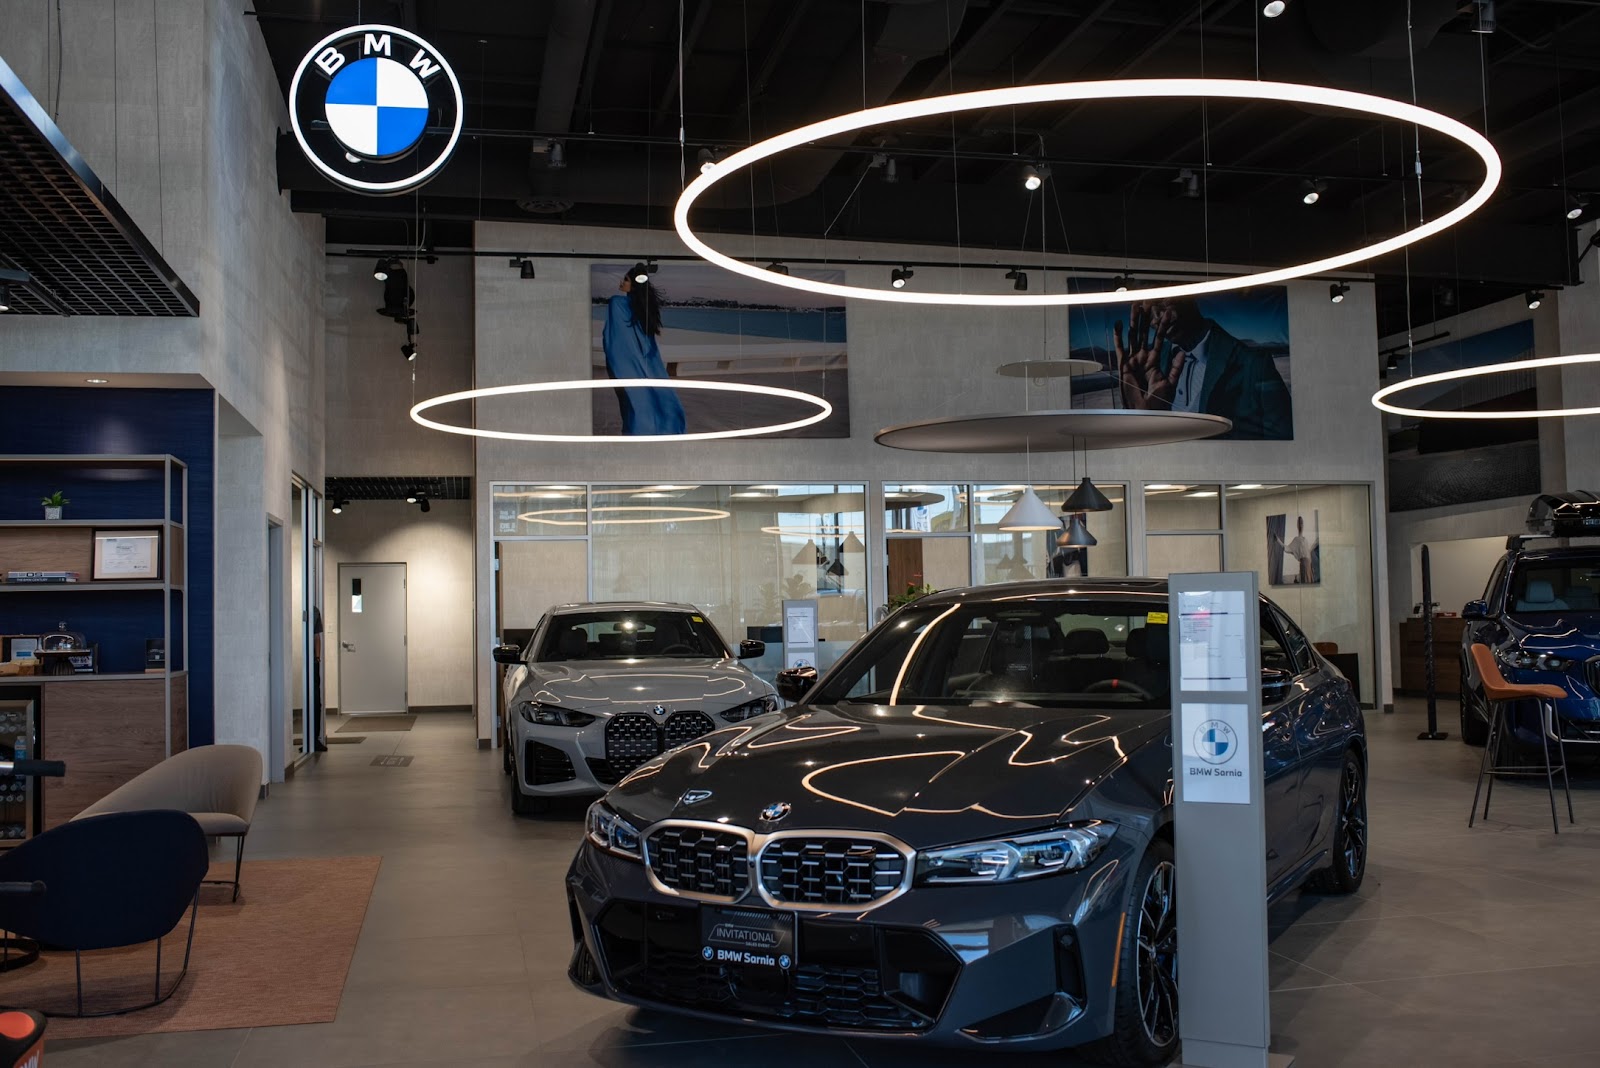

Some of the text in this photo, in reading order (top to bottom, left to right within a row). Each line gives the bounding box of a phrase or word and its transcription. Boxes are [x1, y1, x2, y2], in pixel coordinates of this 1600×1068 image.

[314, 34, 441, 79] BMW
[1199, 722, 1231, 734] BMW
[1214, 768, 1242, 776] Sarnia
[716, 928, 776, 942] INVITATIONAL
[718, 950, 775, 966] BMW Sarnia
